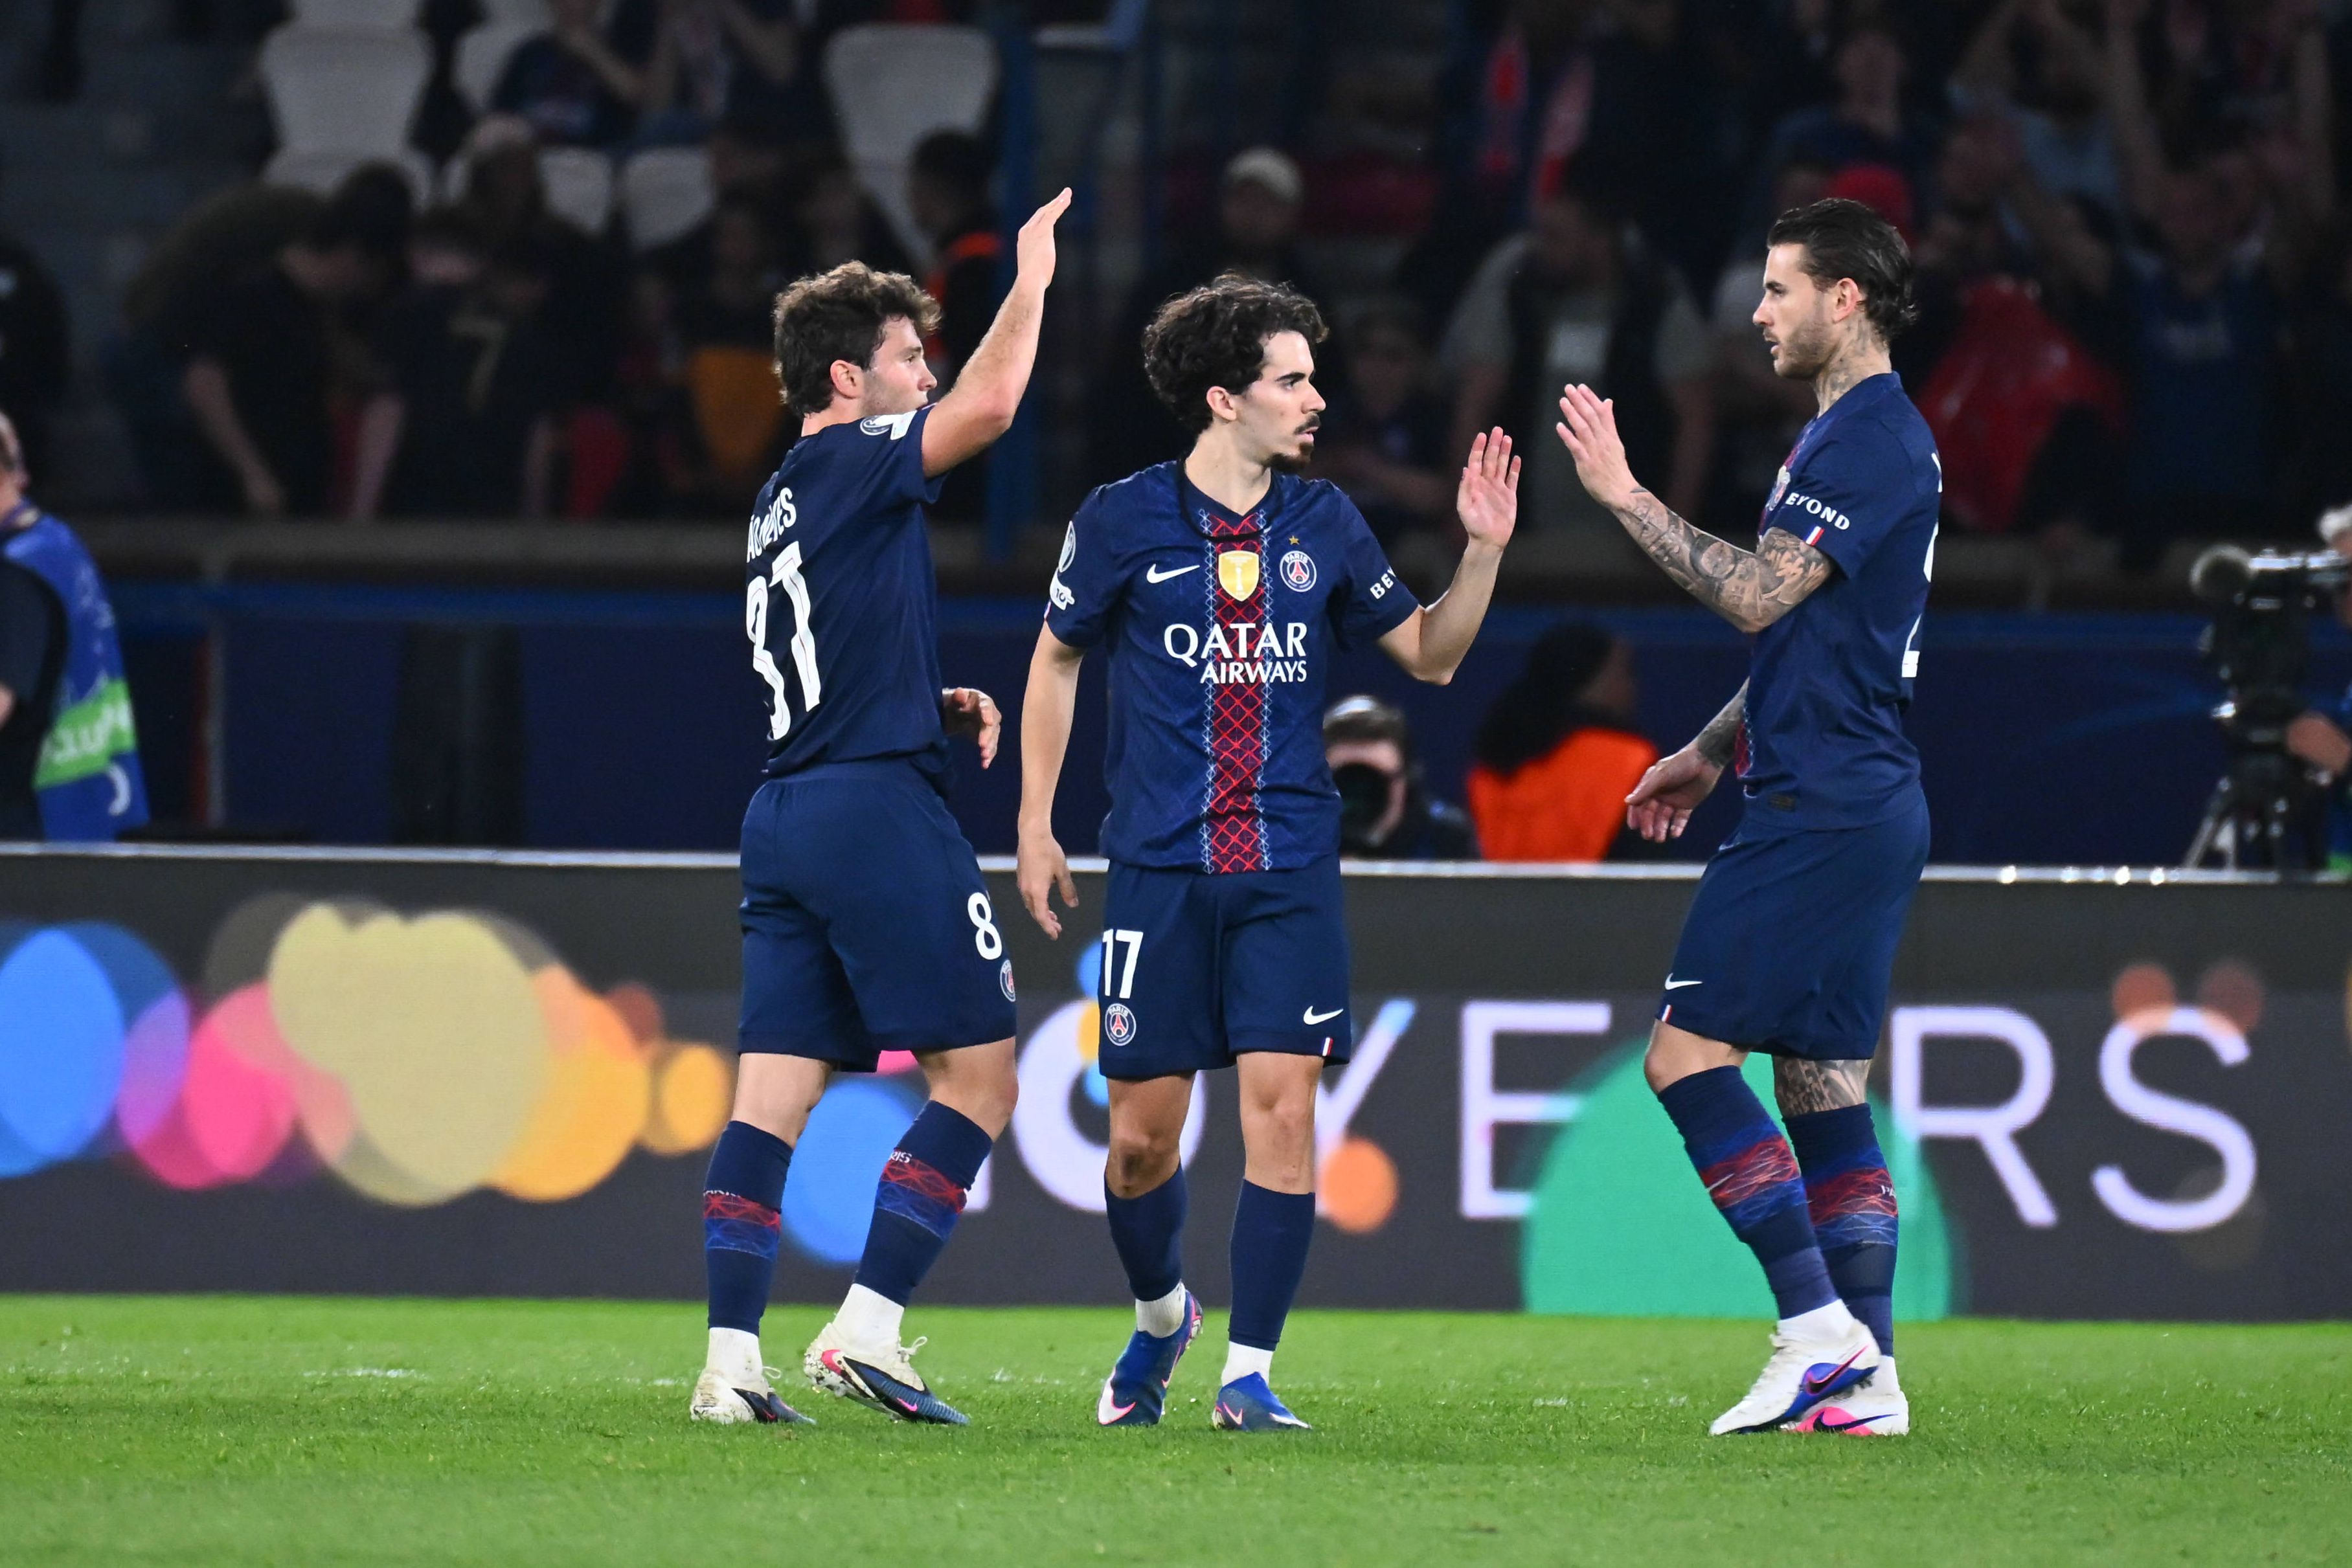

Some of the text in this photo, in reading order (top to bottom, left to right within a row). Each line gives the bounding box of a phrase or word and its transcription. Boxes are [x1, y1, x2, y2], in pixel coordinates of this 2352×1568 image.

[1785, 492, 1850, 530] EYOND
[1284, 552, 1309, 564] PARIS
[1370, 565, 1396, 599] BEY
[1164, 622, 1307, 667] QATAR
[1200, 660, 1307, 684] AIRWAYS
[967, 891, 1002, 960] 8
[1102, 928, 1144, 999] 17
[1108, 1005, 1129, 1017] PARIS
[890, 1151, 912, 1163] RIS
